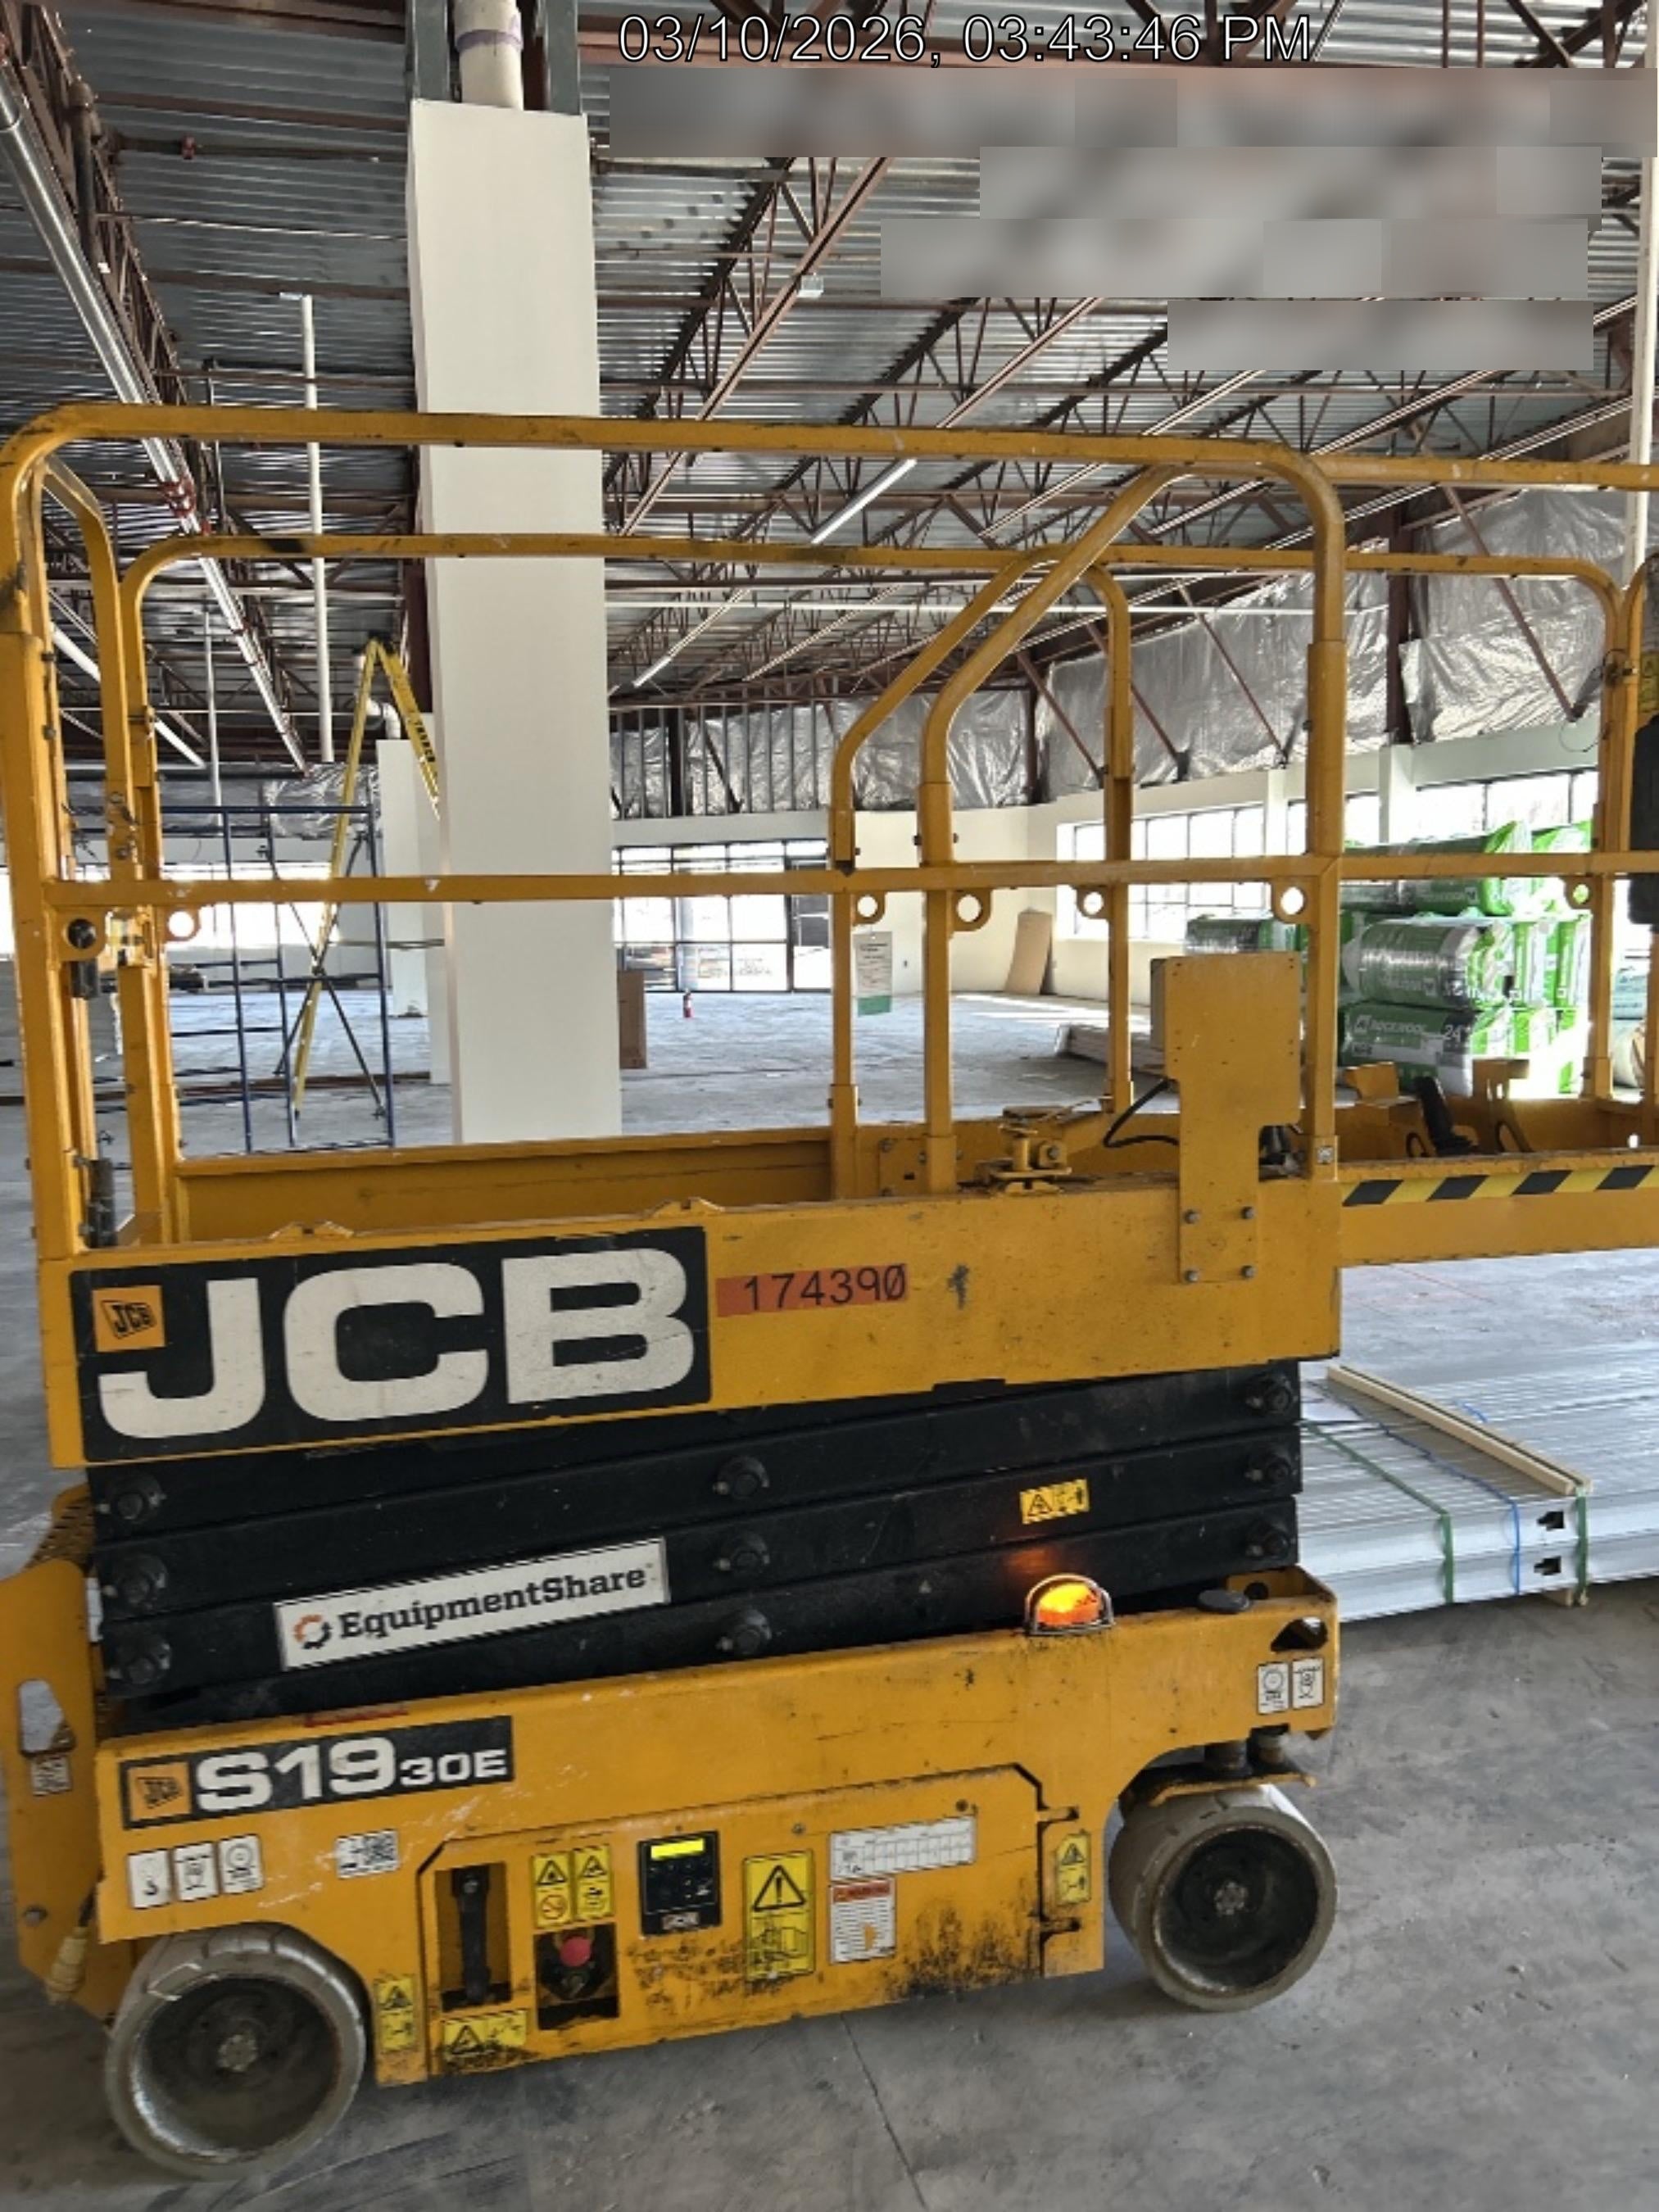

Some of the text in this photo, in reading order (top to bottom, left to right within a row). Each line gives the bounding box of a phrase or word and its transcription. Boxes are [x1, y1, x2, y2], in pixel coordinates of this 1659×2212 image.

[110, 1301, 155, 1336] JCB
[743, 1267, 906, 1312] 174390
[98, 1249, 694, 1439] JCB
[338, 1566, 647, 1639] EquipmentShare
